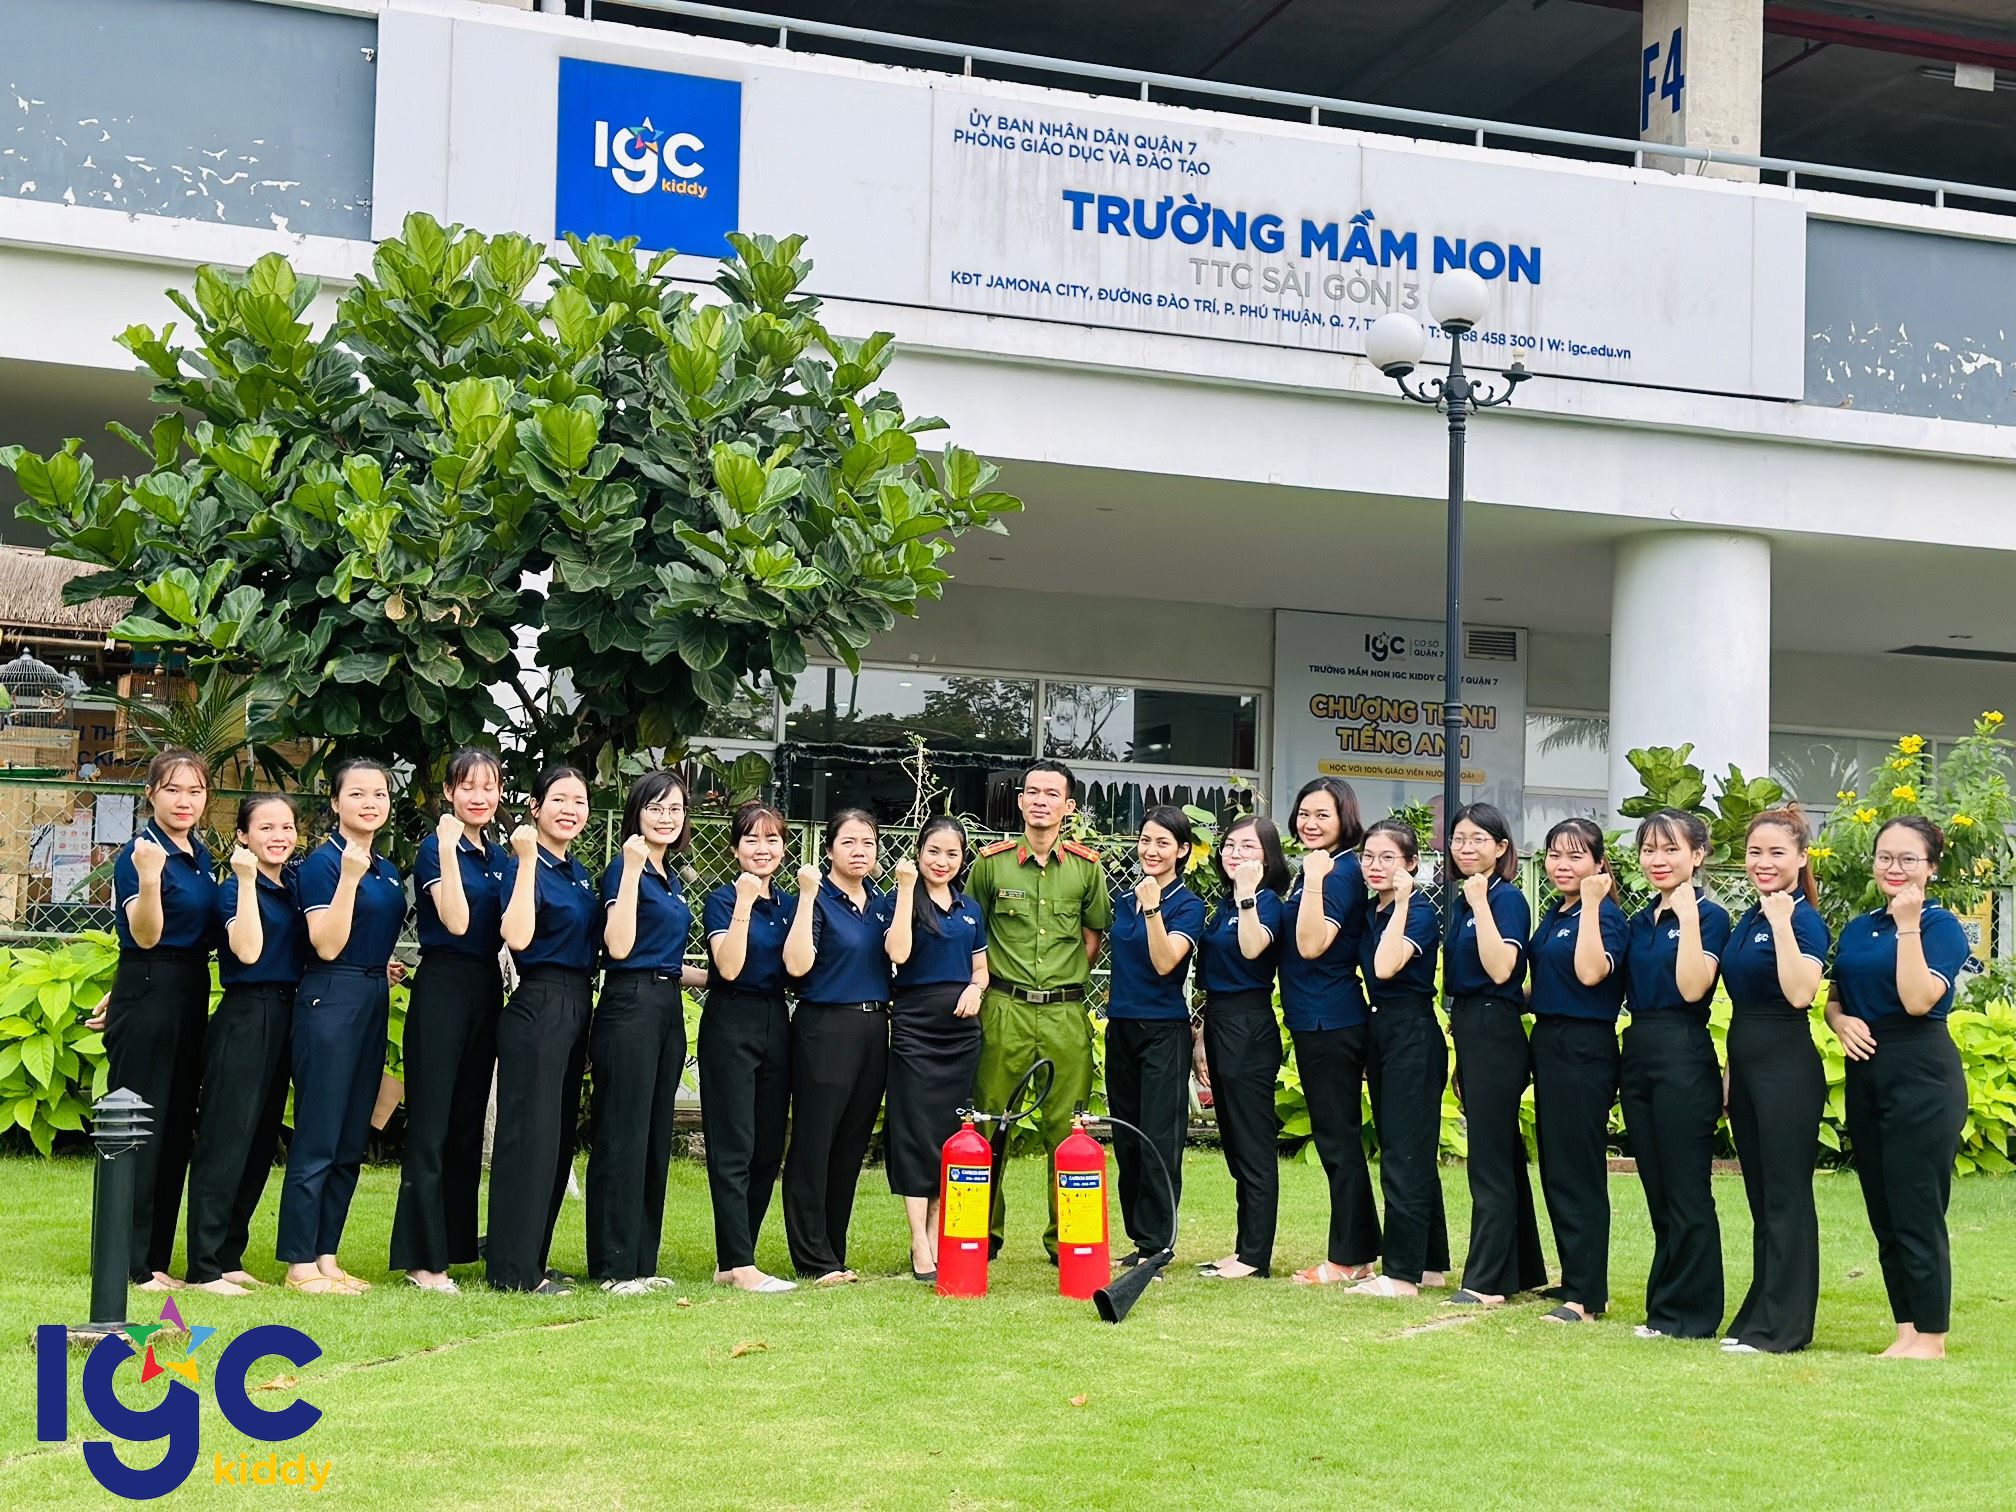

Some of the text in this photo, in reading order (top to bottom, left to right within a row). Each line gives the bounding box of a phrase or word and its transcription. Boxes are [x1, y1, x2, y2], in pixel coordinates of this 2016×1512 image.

[1641, 26, 1685, 132] F4
[954, 129, 1210, 177] PHÒNG GIÁO DỤC VÀ ĐÀO TẠO
[969, 108, 1197, 155] ỦY BAN NHÂN DÂN QUẬN 7
[661, 177, 708, 198] kiddy
[1062, 189, 1541, 285] TRƯỜNG MẦM NON
[1189, 257, 1420, 310] TTC SÀI GÒN 3
[951, 270, 982, 285] KĐT
[986, 275, 1051, 295] JAMONA
[1056, 283, 1093, 301] CITY,
[1097, 287, 1152, 305] ĐƯỜNG
[1157, 294, 1190, 311] ĐÀO
[1194, 297, 1220, 315] TRÍ,
[1224, 303, 1236, 316] P.
[1239, 304, 1268, 319] PHÚ
[1272, 308, 1326, 327] THUẬN,
[1329, 314, 1344, 328] Q.
[1349, 317, 1360, 331] 7,
[1428, 325, 1440, 338] T:
[1444, 330, 1478, 343] 068
[1482, 331, 1506, 345] 458
[1510, 334, 1536, 348] 300
[1547, 338, 1565, 352] W:
[1568, 339, 1632, 360] igc.edu.vn
[1370, 670, 1390, 679] NON
[1392, 671, 1407, 680] IGC
[1409, 672, 1435, 682] KIDDY
[1466, 676, 1491, 687] QUẬN
[1310, 694, 1497, 730] CHƯƠNG TNH
[1336, 721, 1412, 755] TIẾNG
